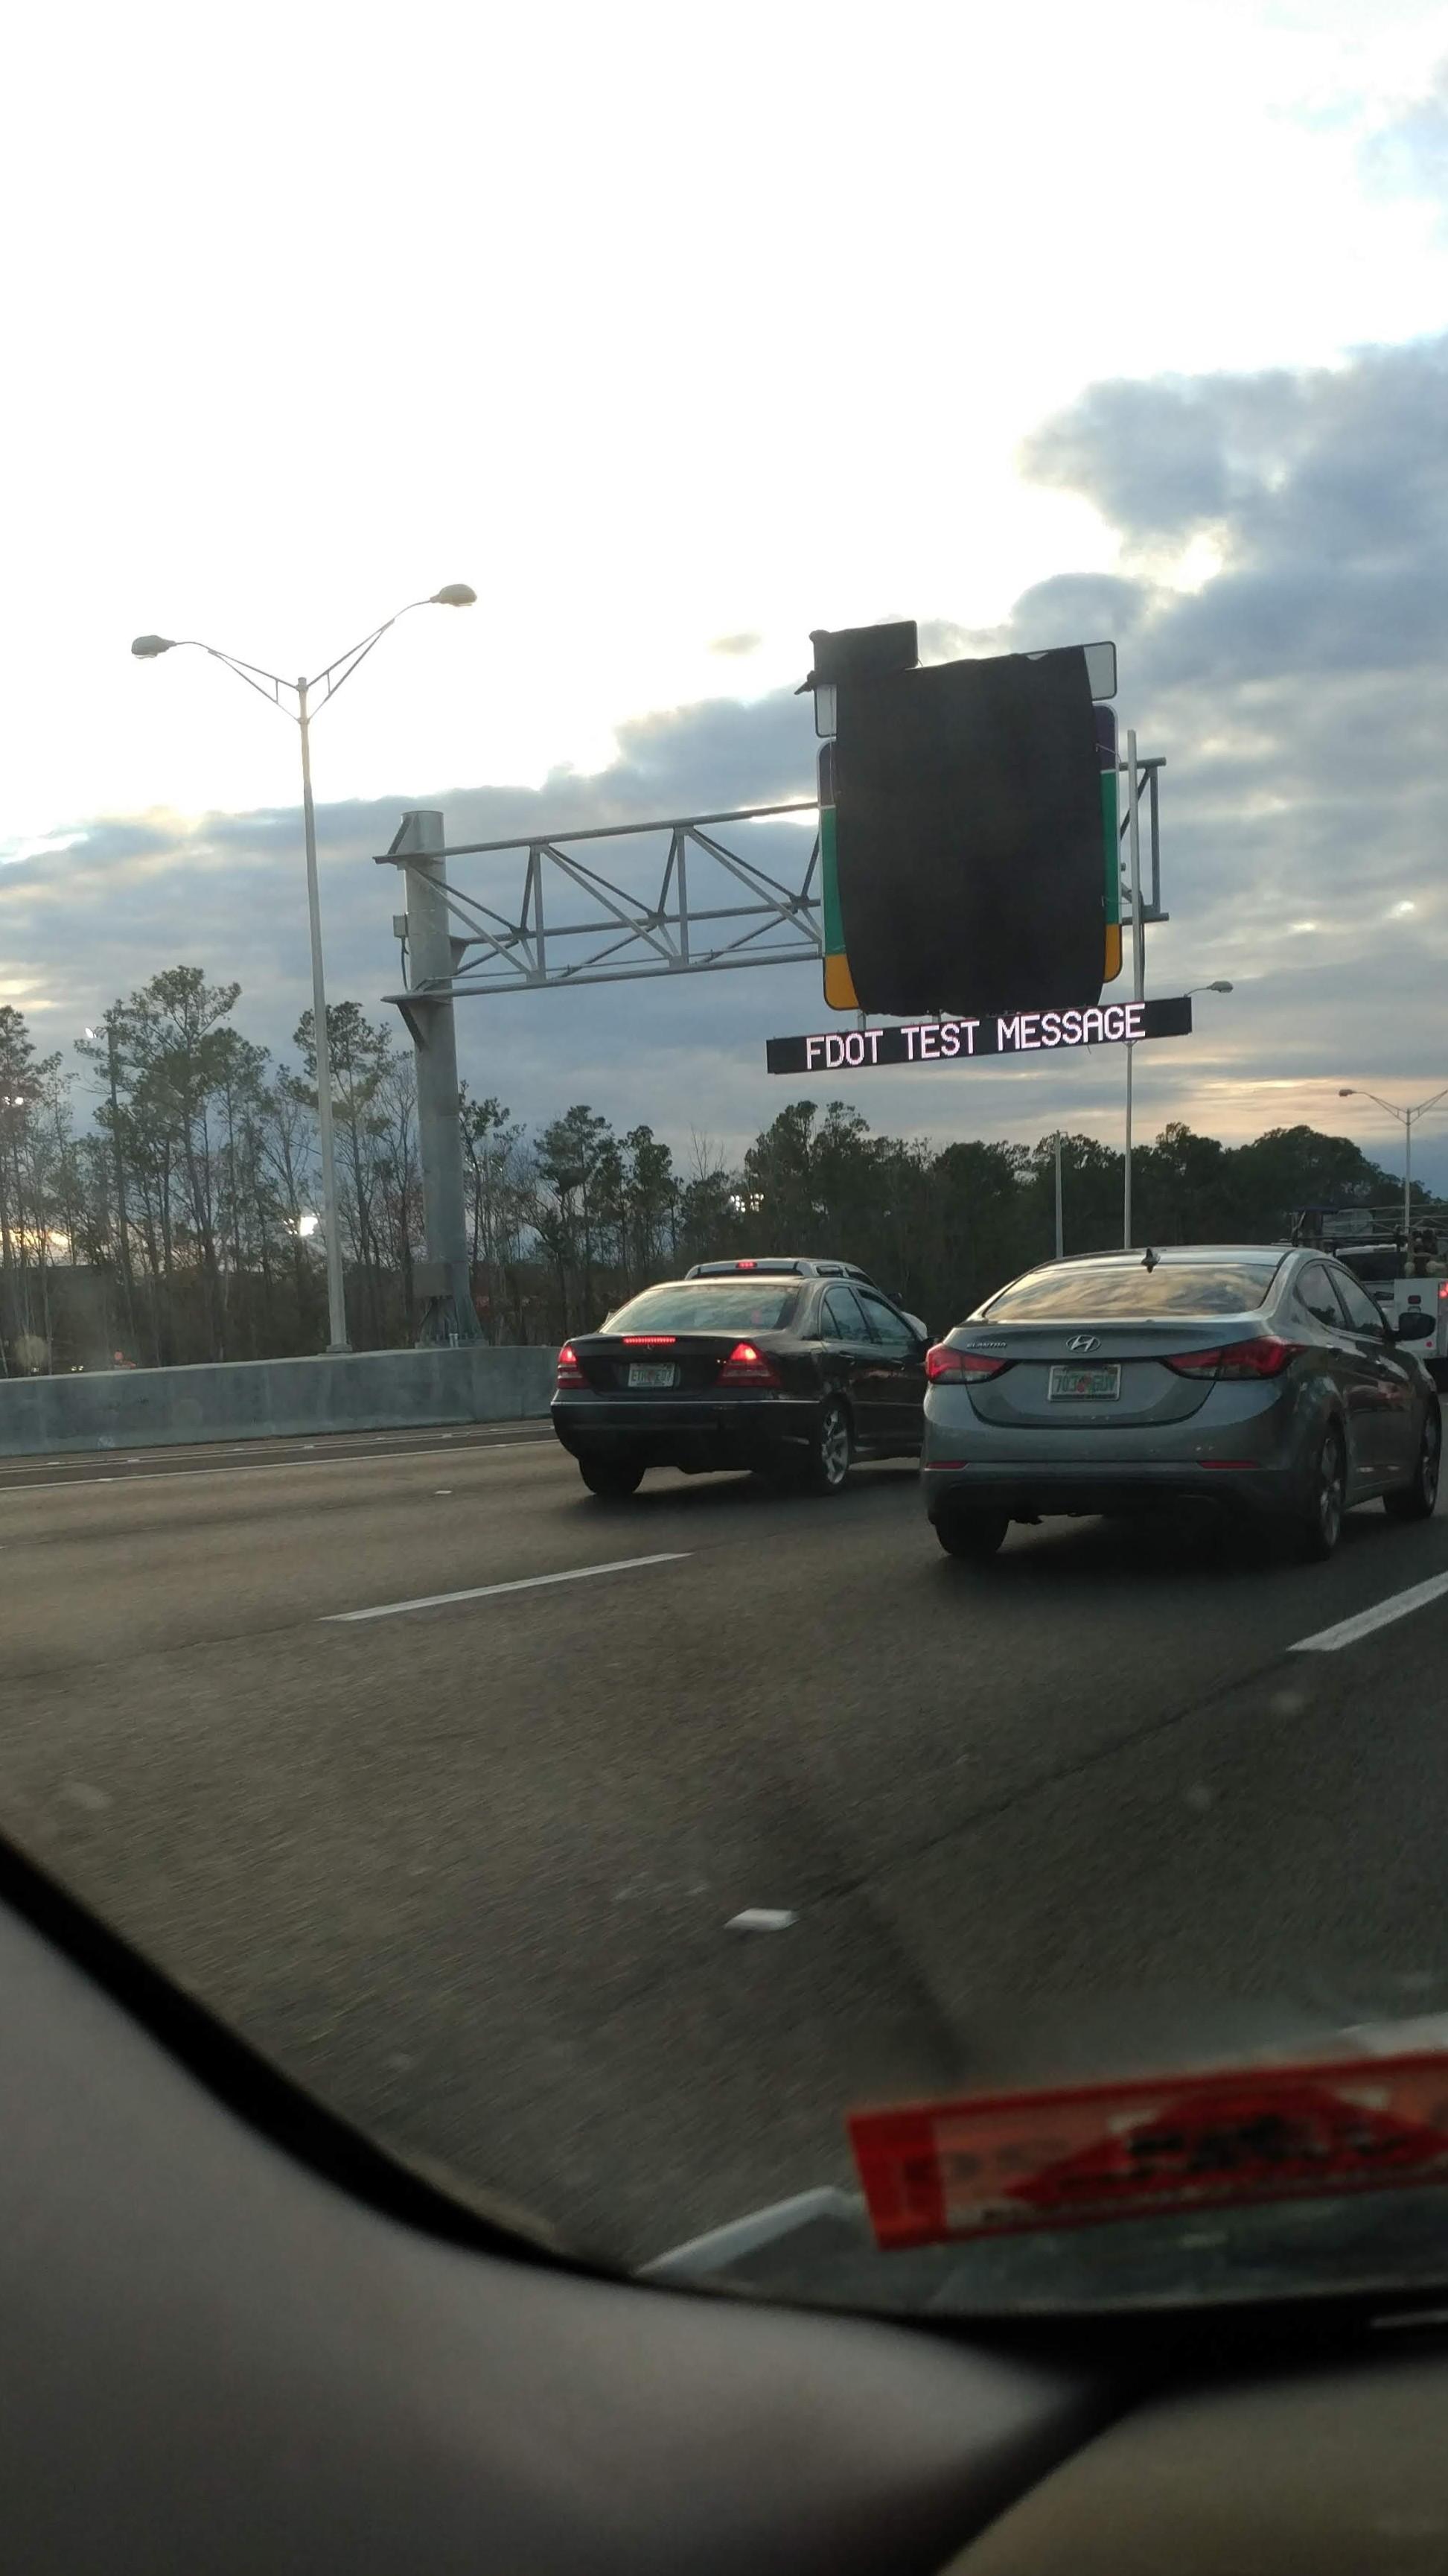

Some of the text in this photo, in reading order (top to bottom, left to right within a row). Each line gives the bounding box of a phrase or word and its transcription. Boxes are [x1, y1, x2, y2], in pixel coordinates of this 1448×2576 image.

[806, 1003, 1146, 1069] FDOT TEST MESSAGE
